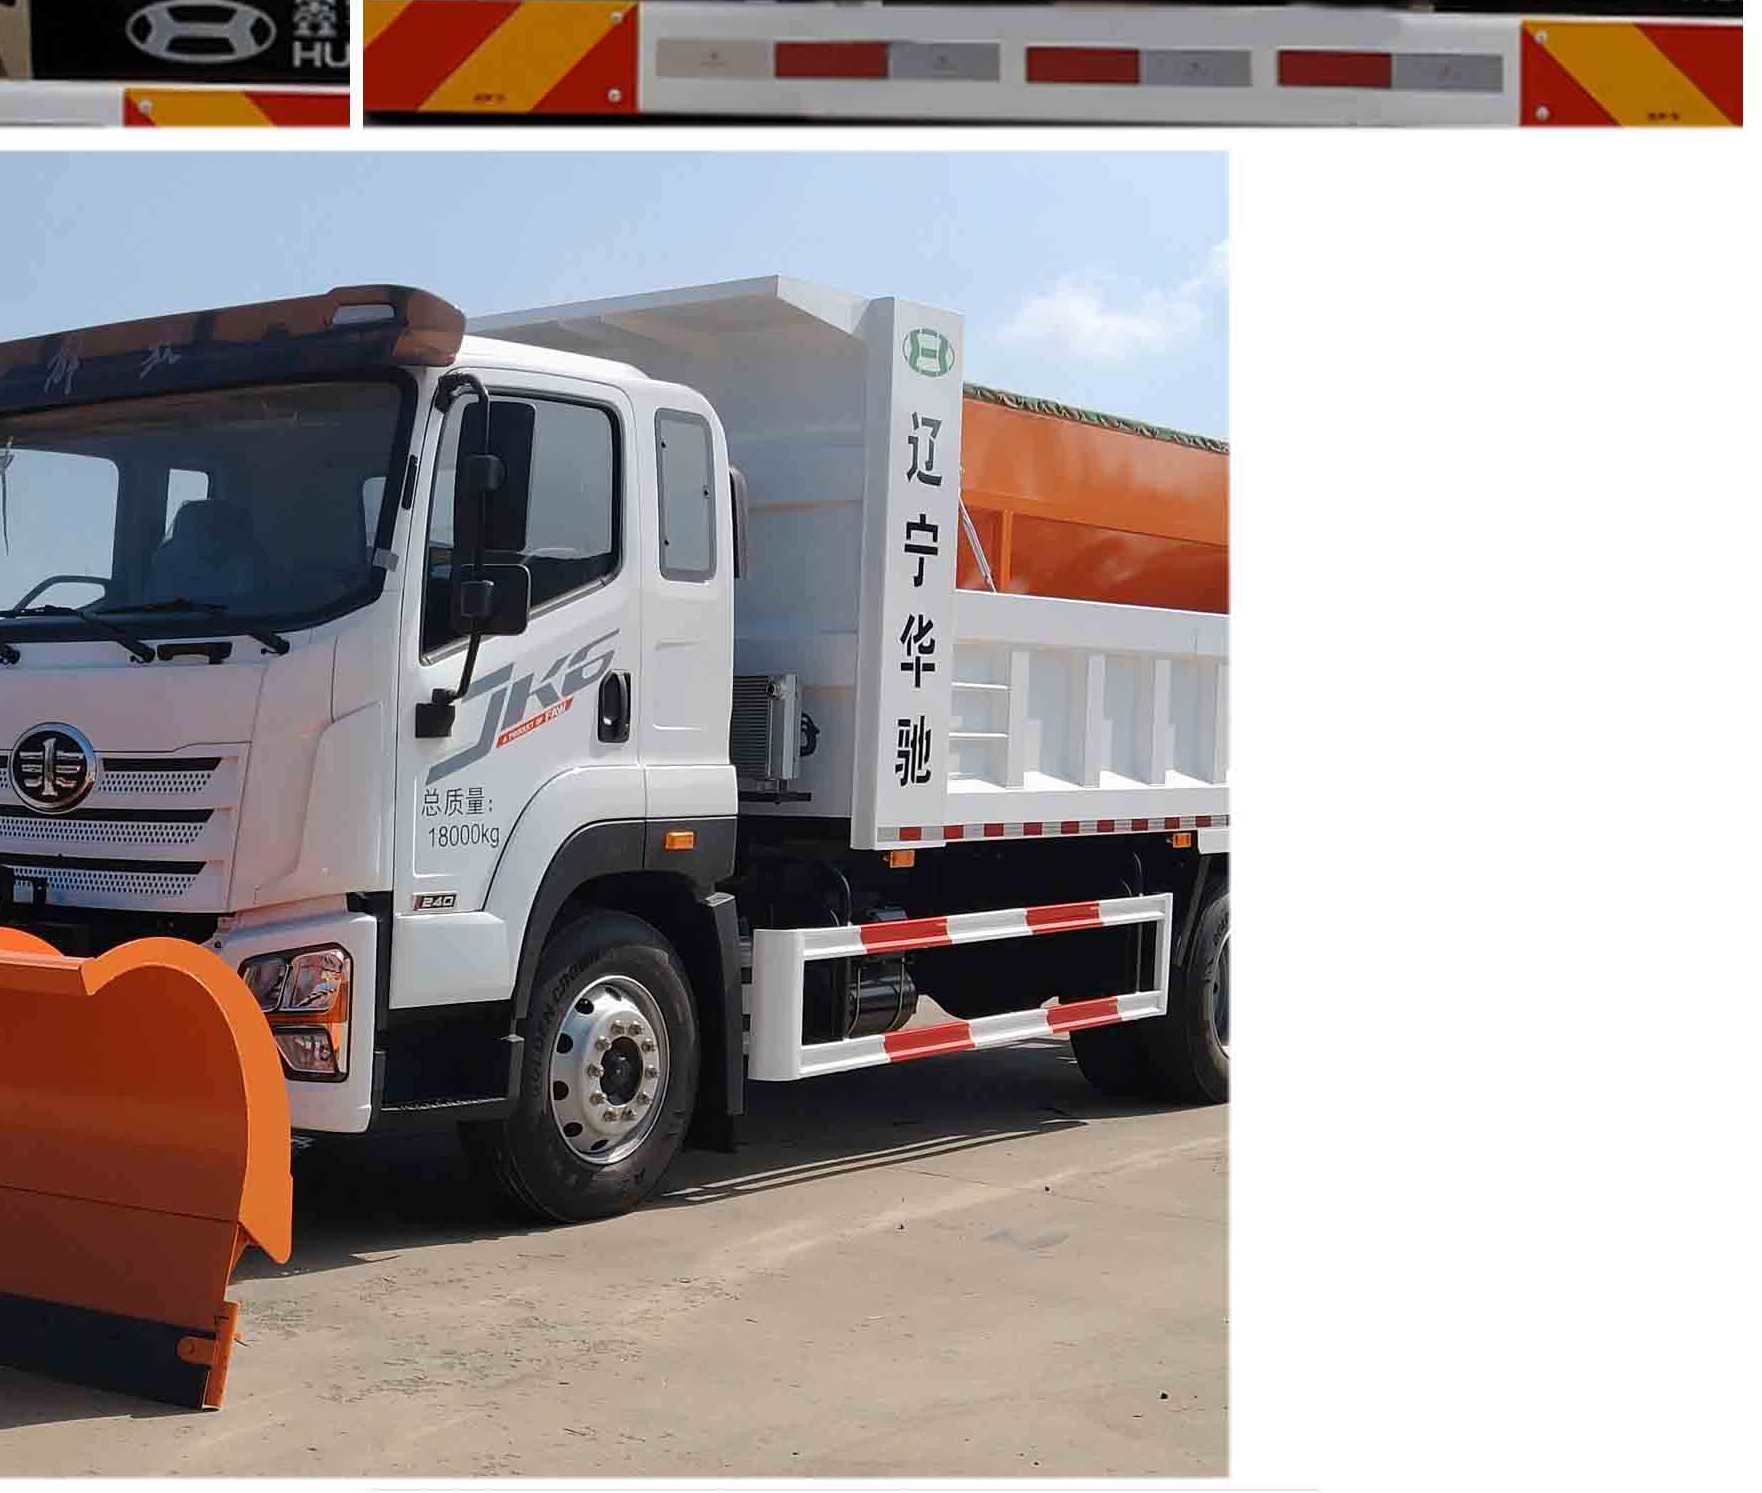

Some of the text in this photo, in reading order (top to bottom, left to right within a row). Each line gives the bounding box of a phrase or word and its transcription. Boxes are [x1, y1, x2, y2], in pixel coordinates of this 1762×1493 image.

[894, 411, 943, 788] 辽宁华驰
[545, 702, 567, 722] FAW
[421, 786, 494, 817] 总质量：
[428, 823, 500, 849] 18000kg
[421, 895, 455, 908] 240
